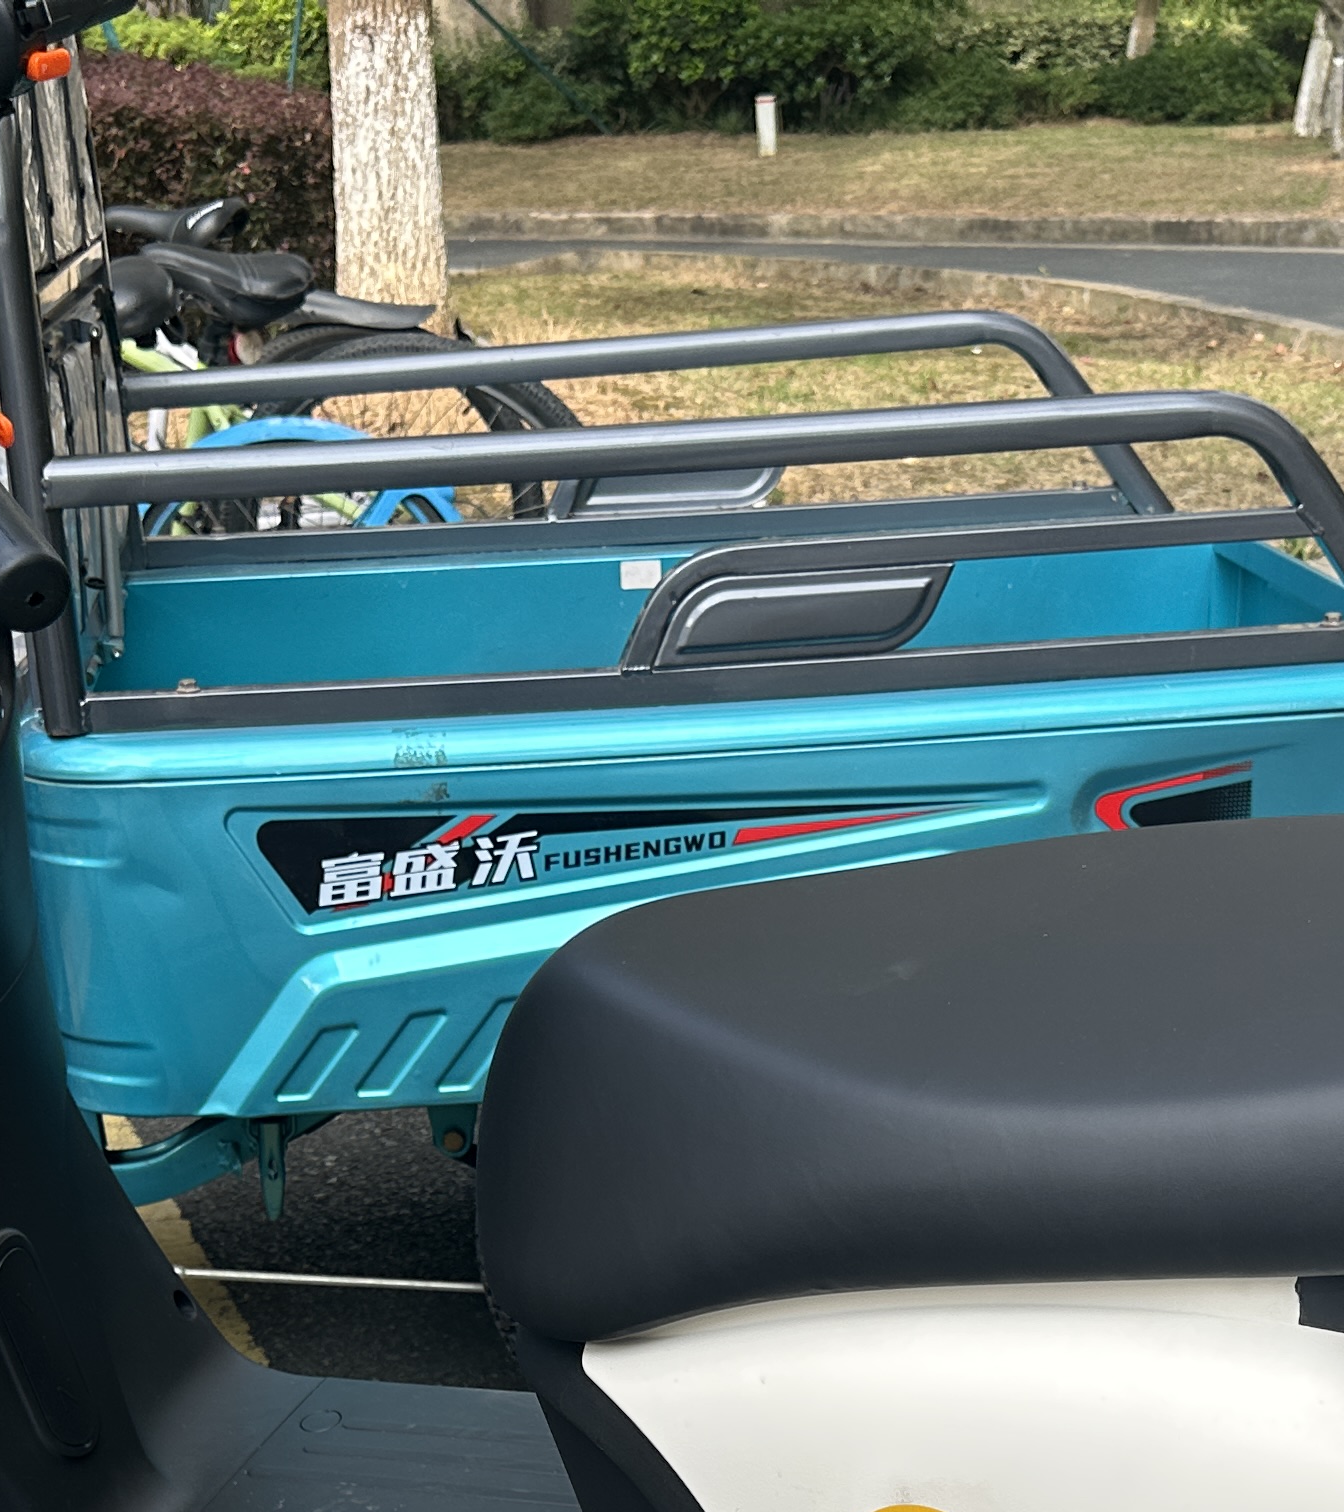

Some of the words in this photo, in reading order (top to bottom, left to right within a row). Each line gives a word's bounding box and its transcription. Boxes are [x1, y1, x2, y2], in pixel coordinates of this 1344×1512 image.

[319, 830, 538, 907] 富盛沃
[544, 831, 727, 872] FUSHENGWO
